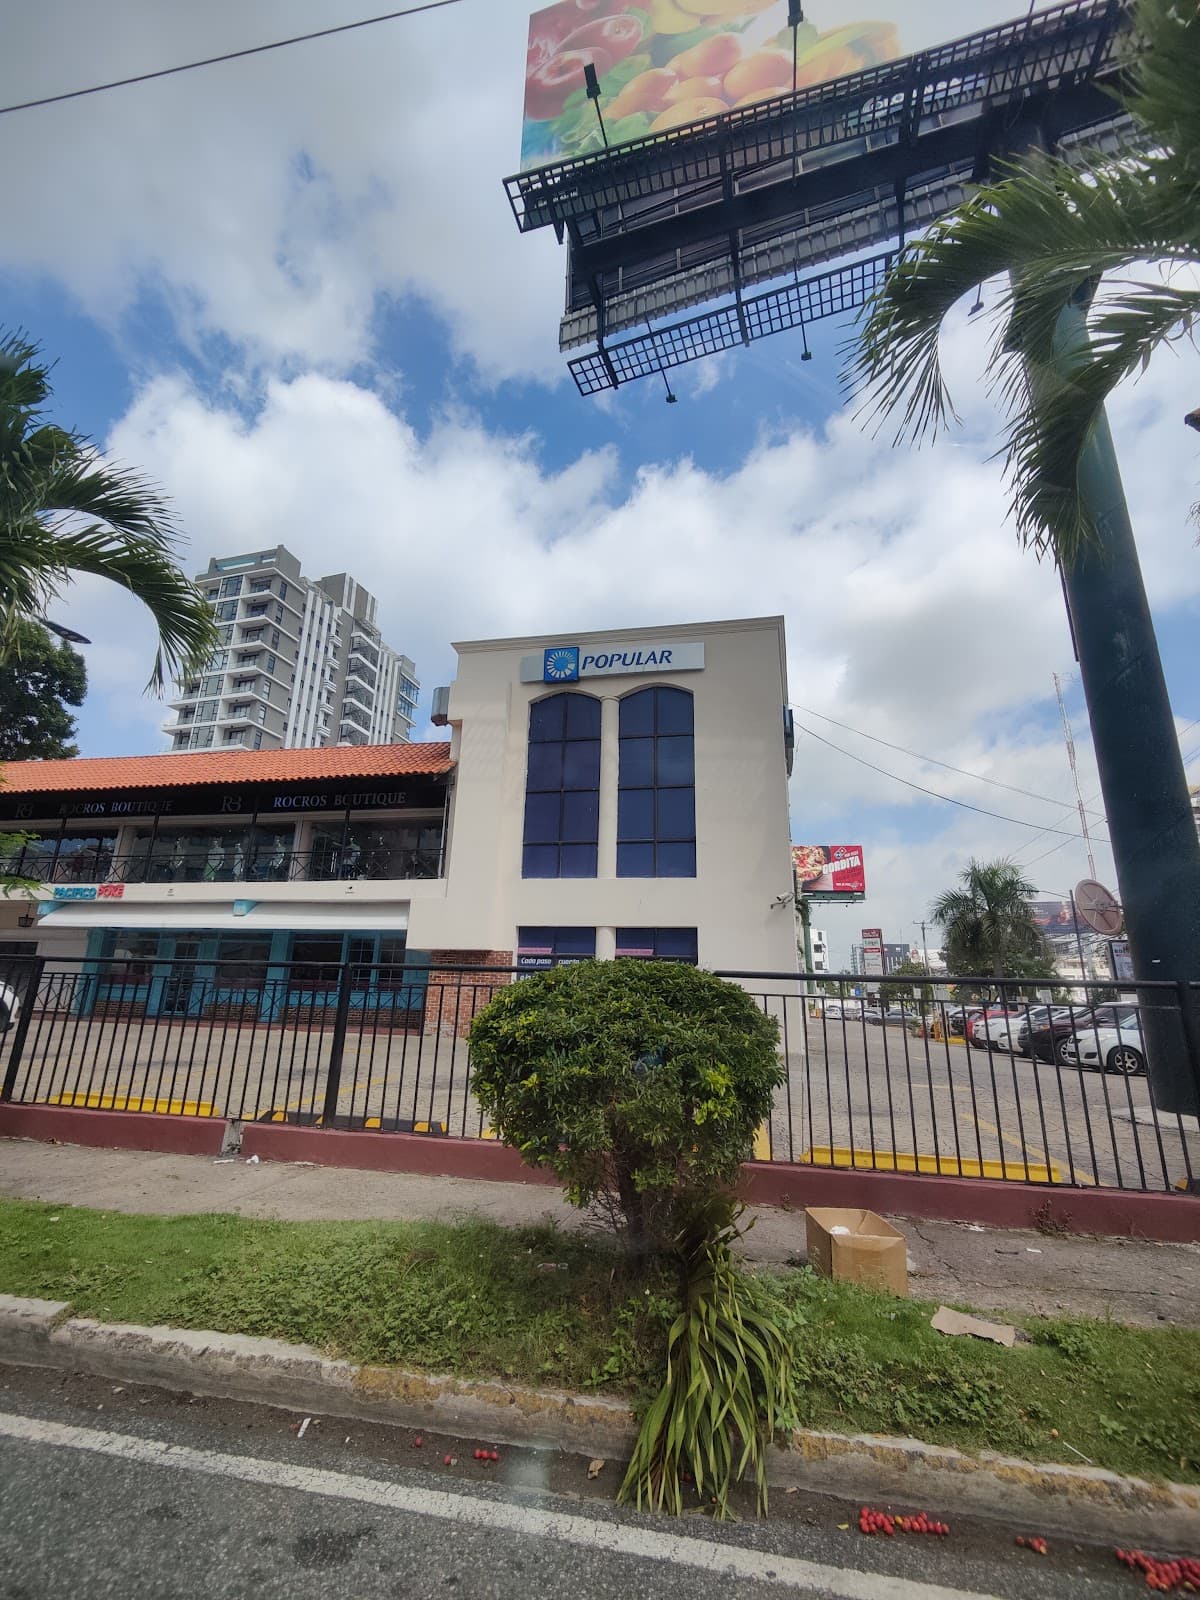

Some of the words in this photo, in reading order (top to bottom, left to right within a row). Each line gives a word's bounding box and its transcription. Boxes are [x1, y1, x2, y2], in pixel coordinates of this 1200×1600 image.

[581, 650, 673, 670] POPULAR
[273, 794, 328, 808] ROCROS
[333, 791, 407, 807] BOUTIQUE
[521, 957, 536, 965] Cada
[535, 958, 552, 966] paso
